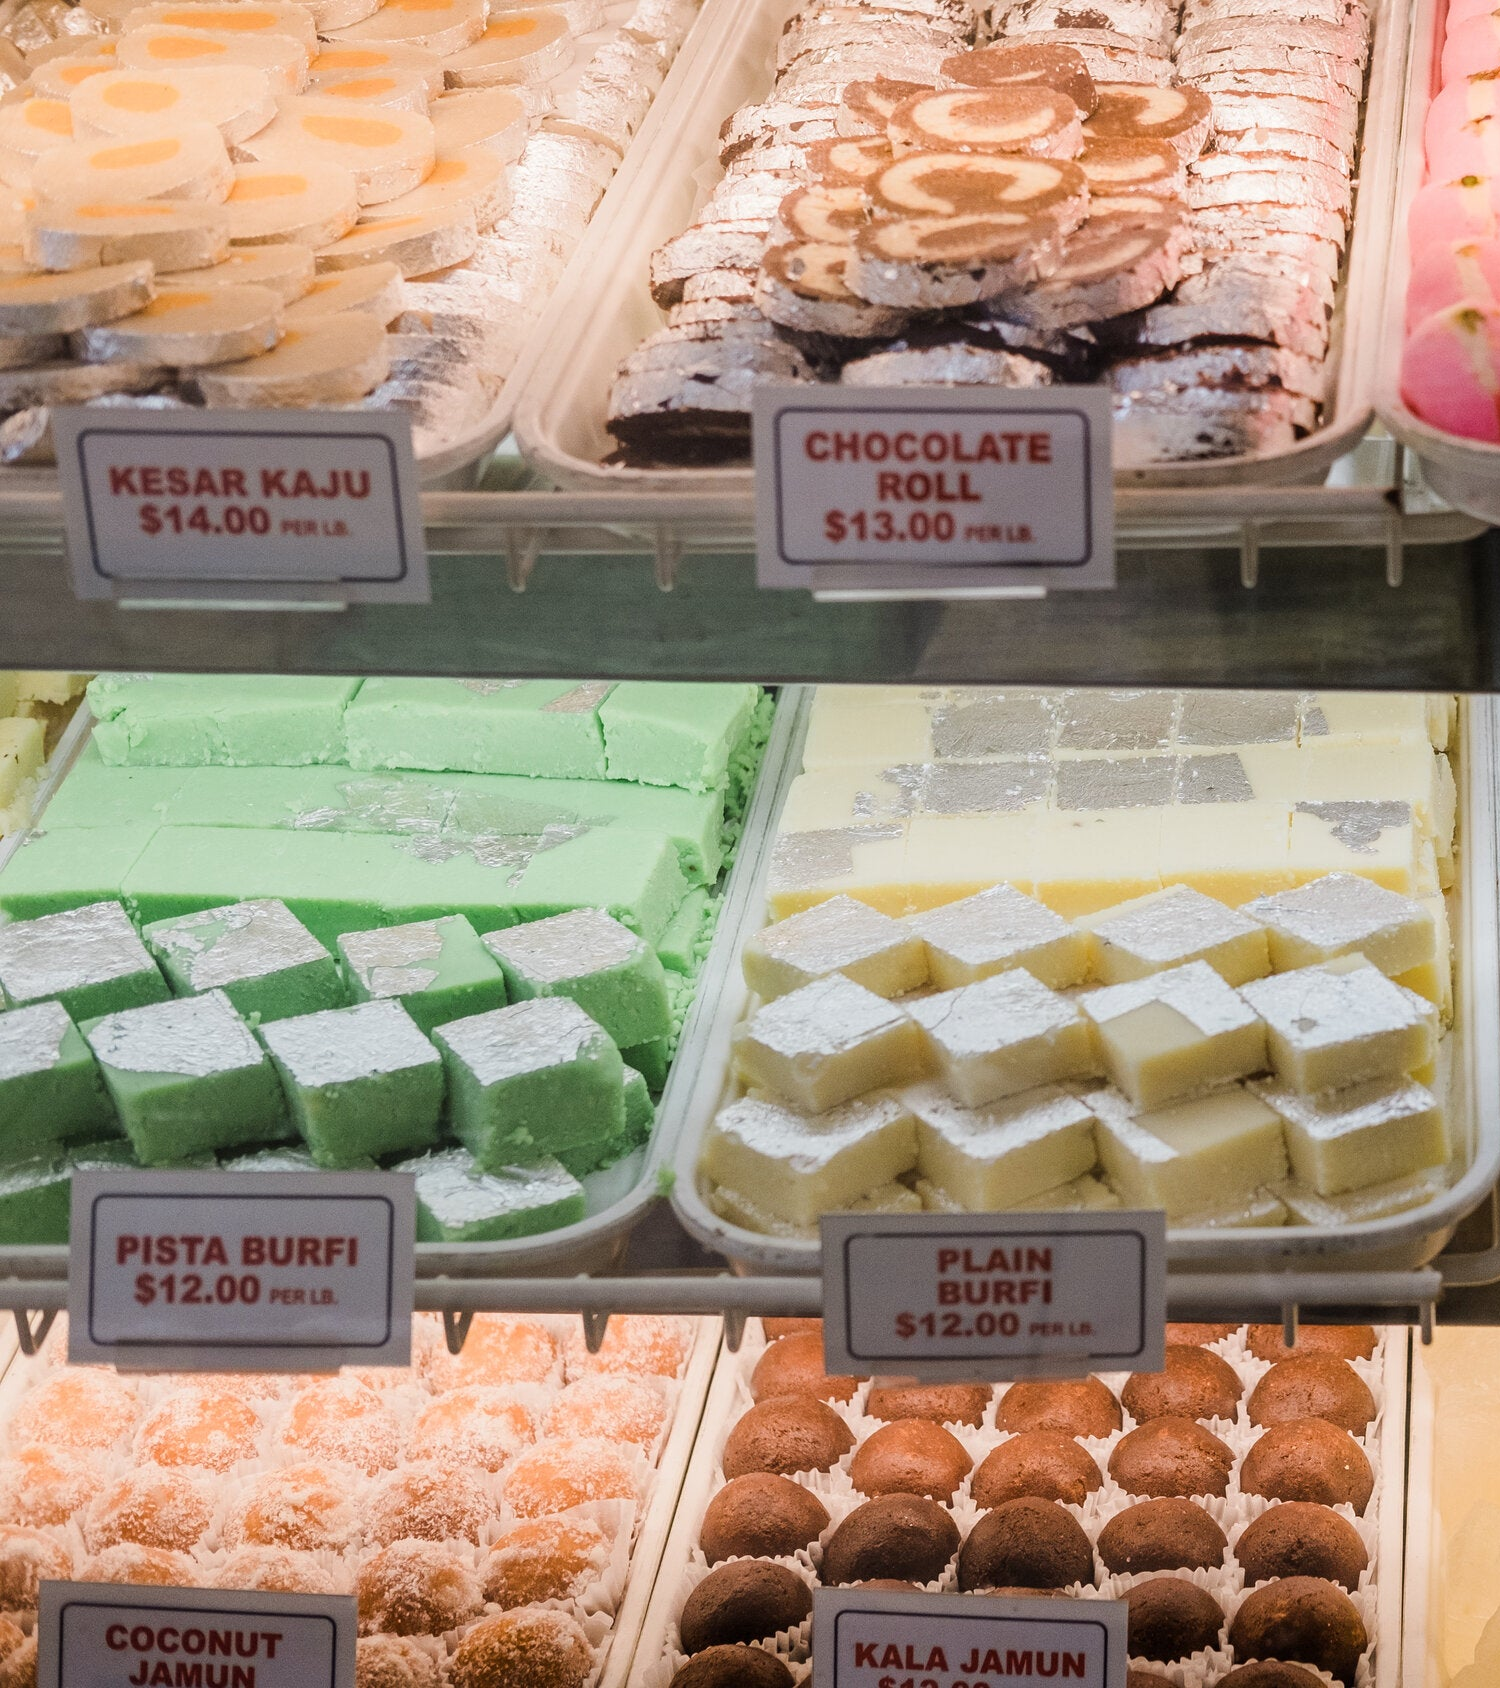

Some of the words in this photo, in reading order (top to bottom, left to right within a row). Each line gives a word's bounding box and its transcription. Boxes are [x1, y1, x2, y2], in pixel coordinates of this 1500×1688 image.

[804, 430, 1051, 464] CHOCOLATE
[108, 466, 248, 498] KESAR
[259, 468, 371, 500] KAJU
[876, 470, 981, 503] ROLL
[139, 503, 272, 536] $14.00
[279, 519, 319, 536] PER
[824, 509, 957, 543] $13.00
[116, 1234, 229, 1267] PISTA
[241, 1235, 358, 1267] BURFI
[937, 1248, 1052, 1275] PLAIN
[135, 1272, 262, 1306] $12.00
[269, 1288, 306, 1304] PER
[307, 1288, 338, 1306] LB.
[937, 1279, 1052, 1306] BURFI
[895, 1310, 1021, 1340] $12.00
[1028, 1322, 1066, 1337] PER
[105, 1624, 282, 1659] COCONUT
[129, 1660, 255, 1688] JAMUN
[855, 1642, 948, 1671] KALA
[960, 1649, 1086, 1678] JAMUN
